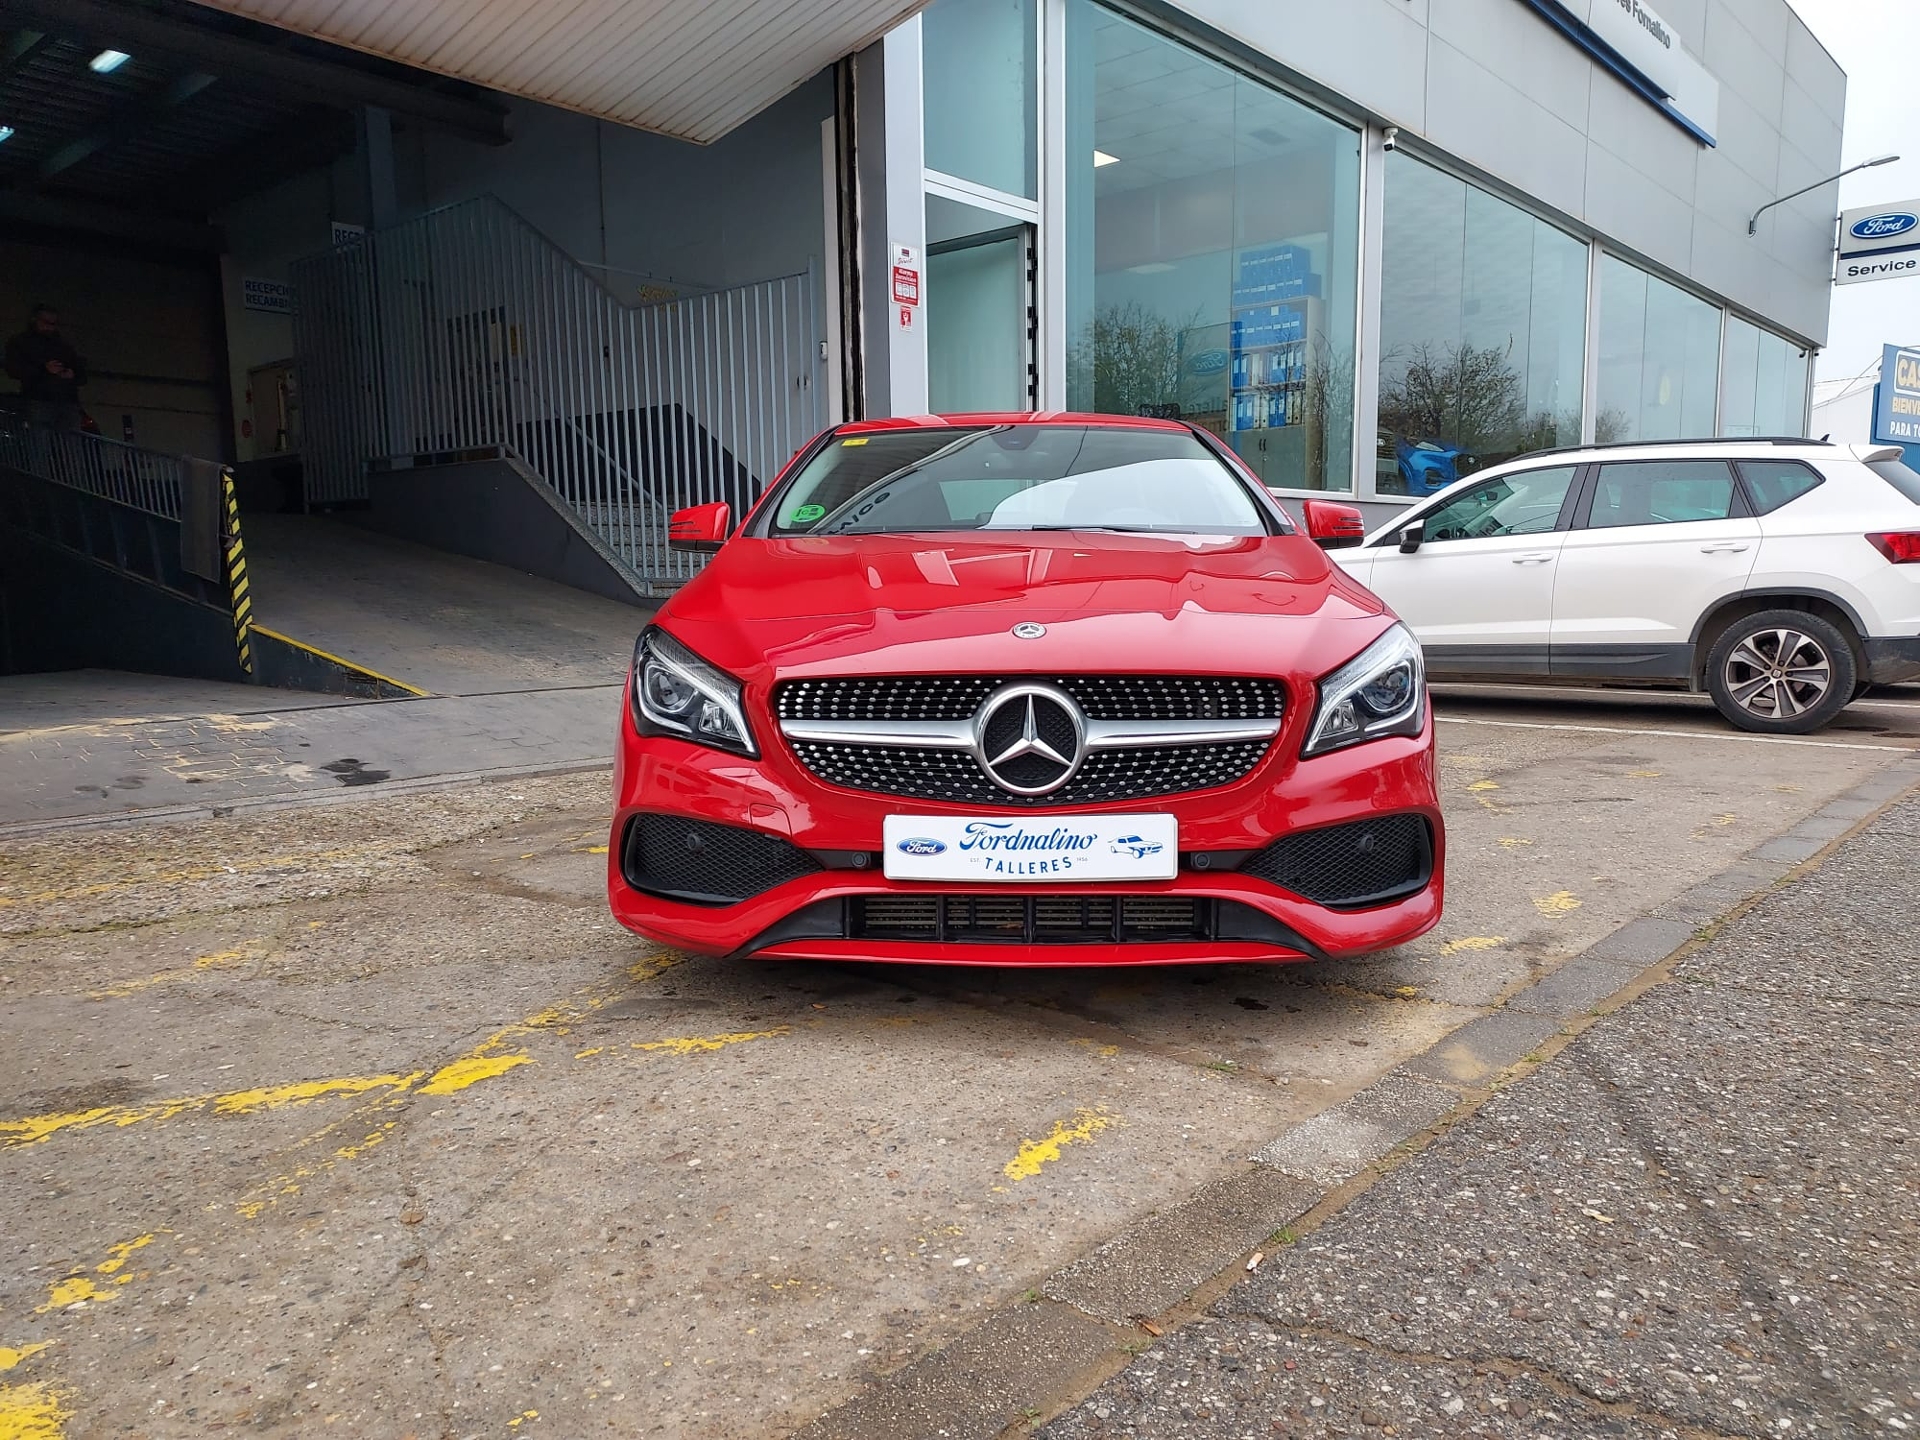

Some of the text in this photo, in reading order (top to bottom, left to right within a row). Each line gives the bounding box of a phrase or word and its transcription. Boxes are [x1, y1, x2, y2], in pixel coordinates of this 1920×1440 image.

[1863, 216, 1906, 234] Ford
[1847, 260, 1917, 277] Service
[245, 293, 289, 308] RECAMBI
[1890, 421, 1911, 437] PARA
[959, 822, 1098, 851] Fordnalino
[906, 840, 938, 853] Ford
[985, 856, 1072, 875] TALLERES
